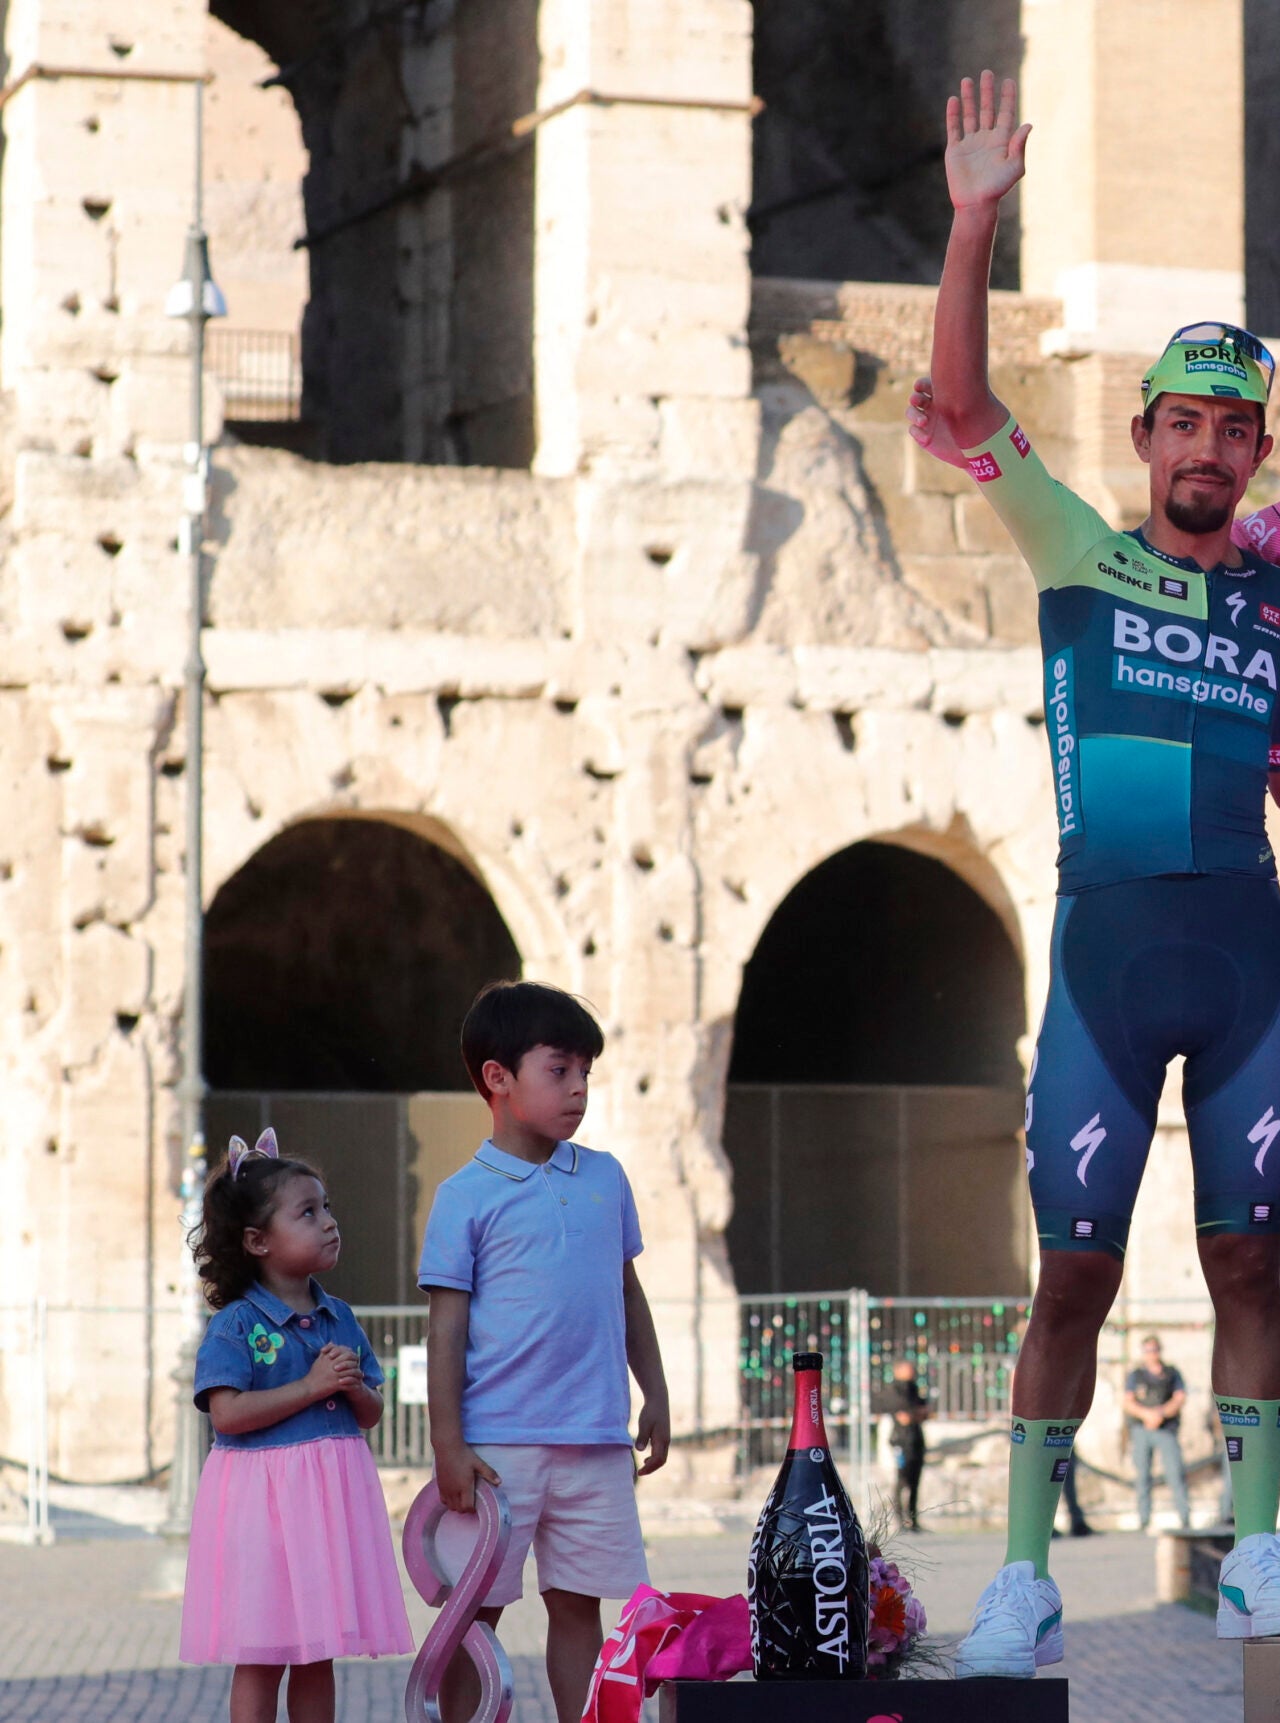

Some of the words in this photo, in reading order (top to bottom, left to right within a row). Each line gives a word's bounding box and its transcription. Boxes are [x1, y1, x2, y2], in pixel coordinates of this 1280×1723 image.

[1184, 347, 1246, 370] BORA
[1187, 363, 1246, 379] hansgrohe
[1098, 562, 1152, 592] GRENKE
[1263, 606, 1280, 619] ÖTZ
[1263, 613, 1280, 625] TAL
[1113, 608, 1277, 691] BORA
[1117, 655, 1269, 714] hansgrohe
[1049, 658, 1076, 836] hansgrohe
[810, 1384, 820, 1429] ASTORIA
[804, 1483, 850, 1674] ASTORIA
